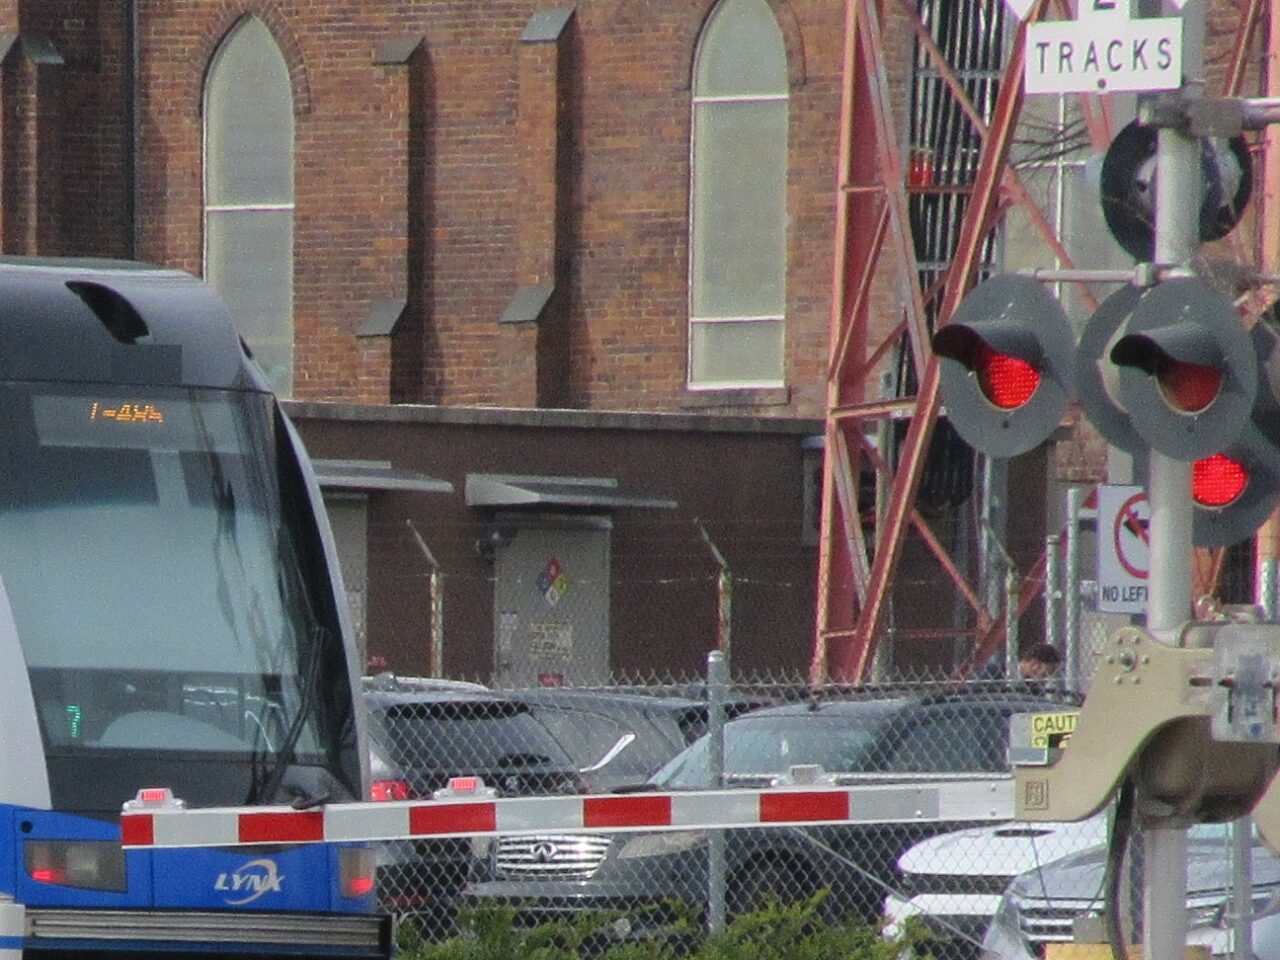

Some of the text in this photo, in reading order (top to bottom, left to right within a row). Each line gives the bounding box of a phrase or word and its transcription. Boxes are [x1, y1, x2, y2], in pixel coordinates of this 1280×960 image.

[1036, 38, 1172, 73] TRACKS
[1102, 586, 1119, 603] NO
[1033, 714, 1074, 732] CAUT
[214, 871, 287, 893] LYNX
